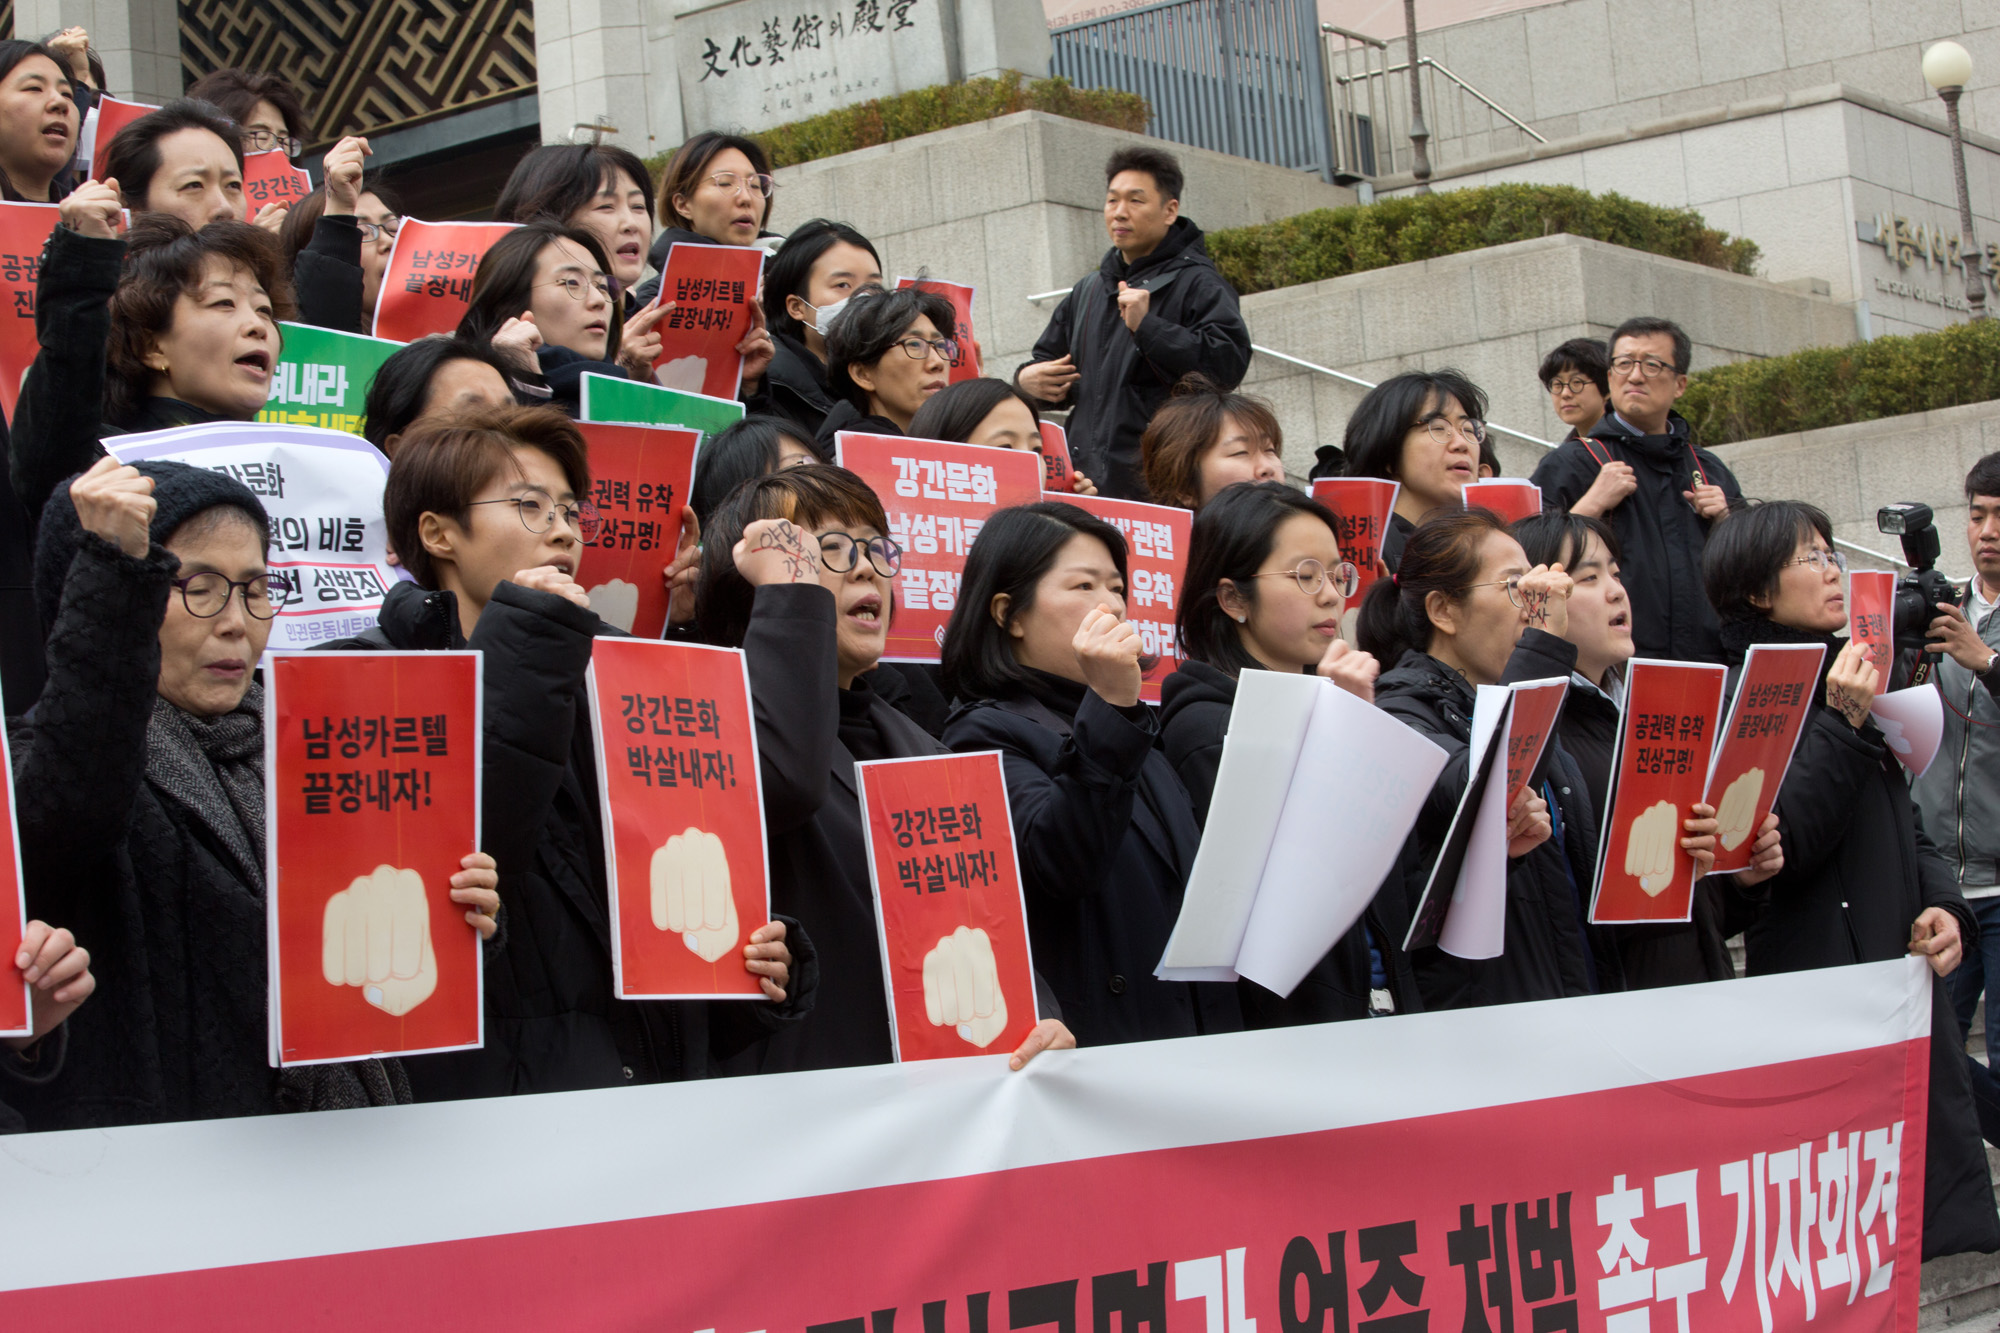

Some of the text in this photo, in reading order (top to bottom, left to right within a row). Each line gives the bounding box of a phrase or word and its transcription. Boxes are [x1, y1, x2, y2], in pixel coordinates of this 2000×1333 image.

[412, 250, 478, 274] 남성카
[14, 289, 35, 319] 진
[404, 272, 474, 304] 끝장내
[676, 278, 745, 304] 남성카르텔
[668, 306, 734, 331] 끝장내자!
[588, 479, 674, 515] 권력 유착
[891, 456, 998, 505] 강간문화
[318, 518, 366, 553] 비호
[1341, 514, 1379, 540] 성카
[313, 568, 390, 603] 성범죄
[1132, 569, 1175, 610] 유착
[1746, 682, 1806, 708] 남성카르텔
[621, 693, 720, 740] 강간문화
[1635, 714, 1705, 742] 공권력 유착
[1736, 713, 1789, 739] 끝장내자!
[302, 714, 448, 760] 남성카르텔
[627, 745, 736, 791] 박살내자!
[1636, 747, 1695, 775] 진상규명!
[302, 768, 432, 815] 끝장내자!
[891, 802, 982, 849] 강간문화
[897, 849, 998, 896] 박살내자!
[1596, 1168, 1708, 1333] 촉구
[1719, 1120, 1904, 1333] 기자회견
